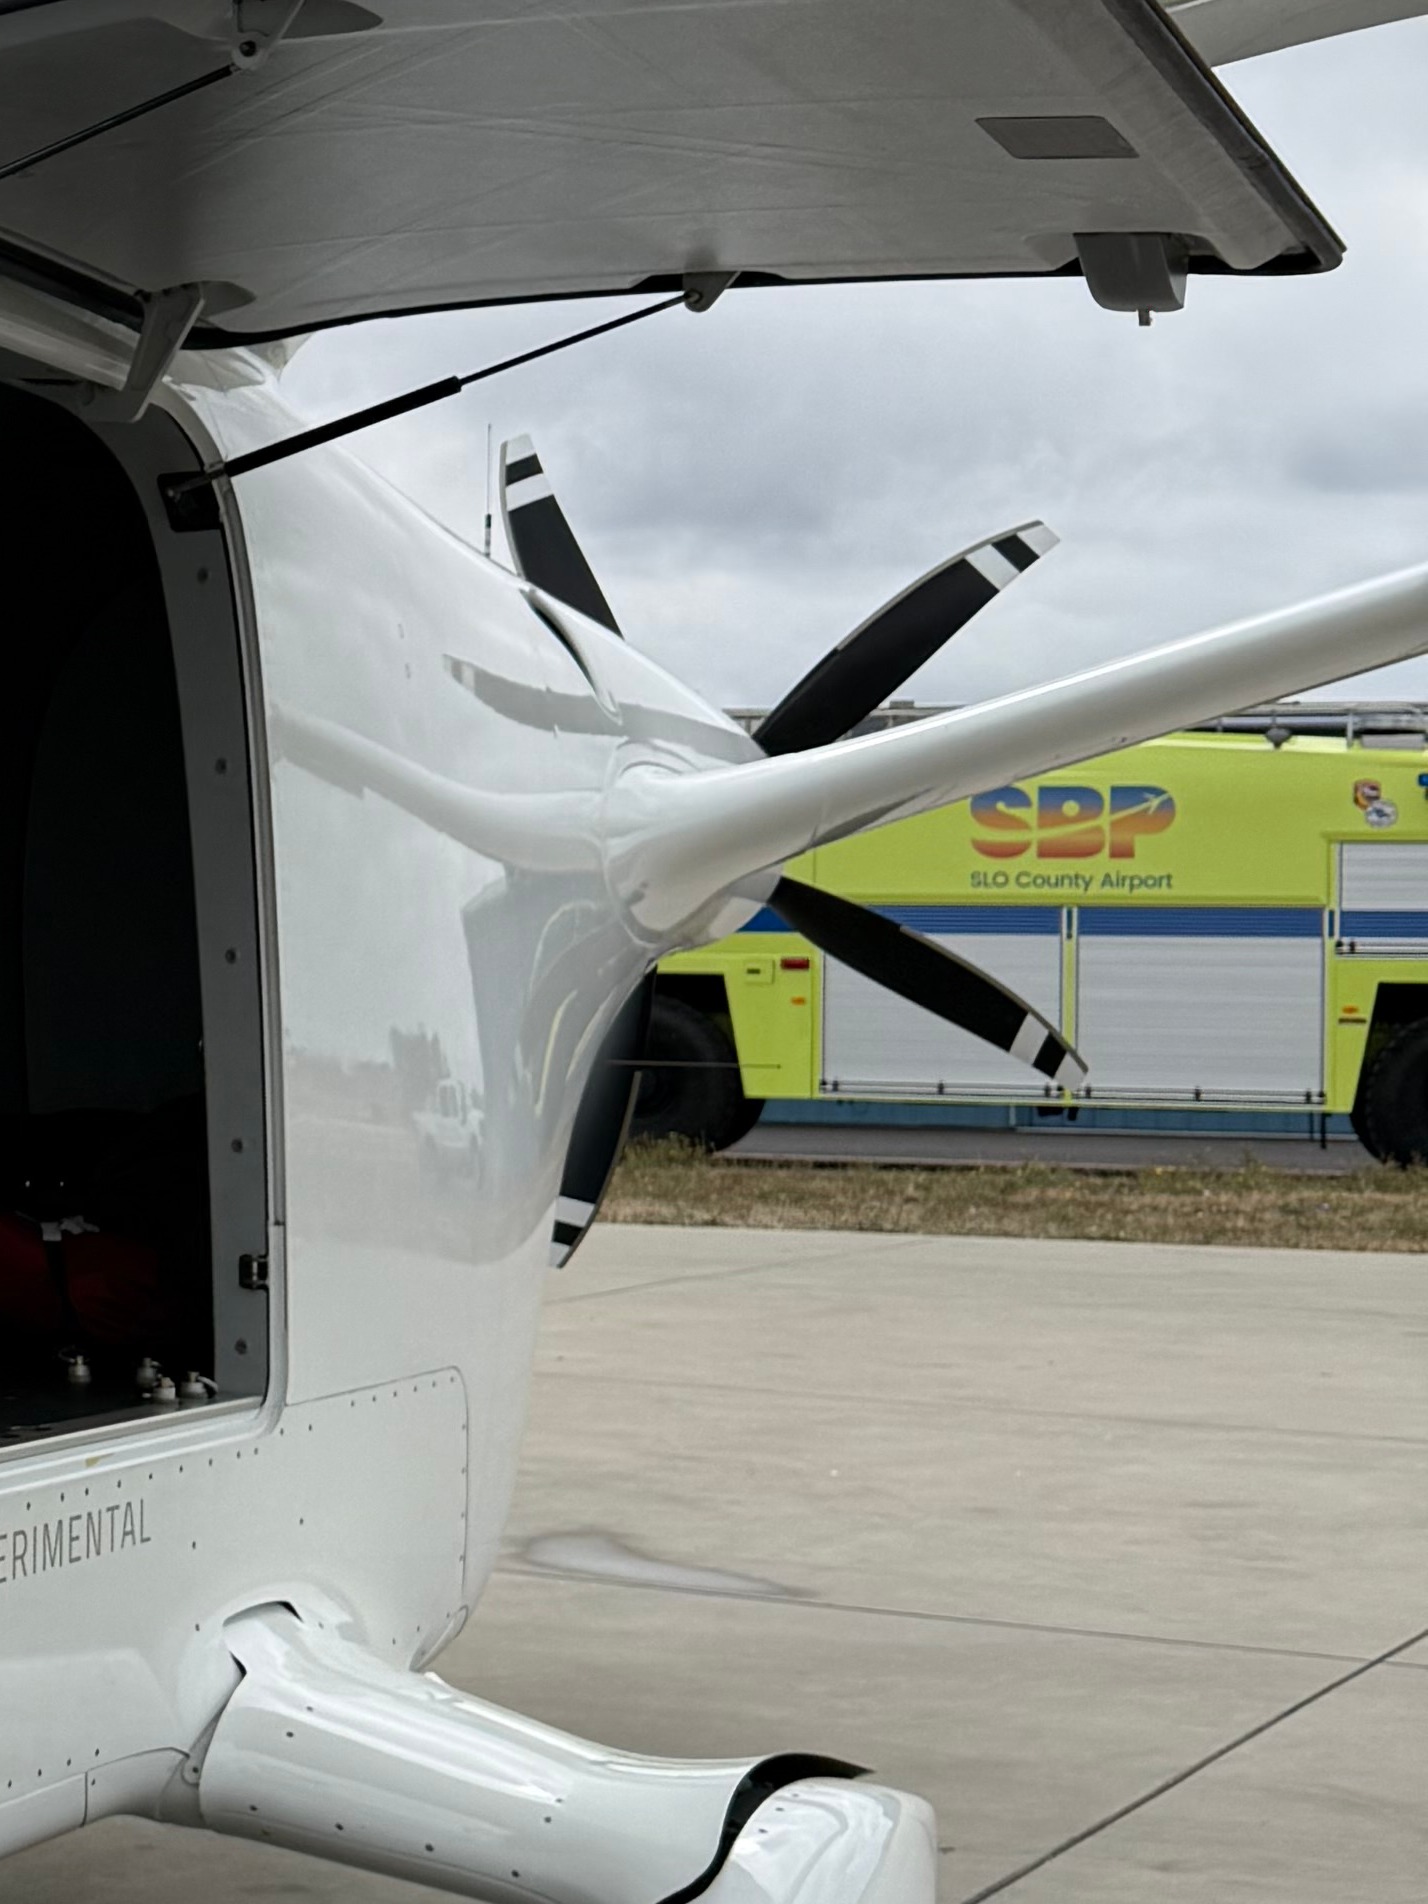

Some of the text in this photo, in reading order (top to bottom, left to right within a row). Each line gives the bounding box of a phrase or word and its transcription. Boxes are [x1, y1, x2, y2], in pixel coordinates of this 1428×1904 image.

[970, 785, 1176, 858] SBP
[970, 870, 1173, 893] SLO County Airport
